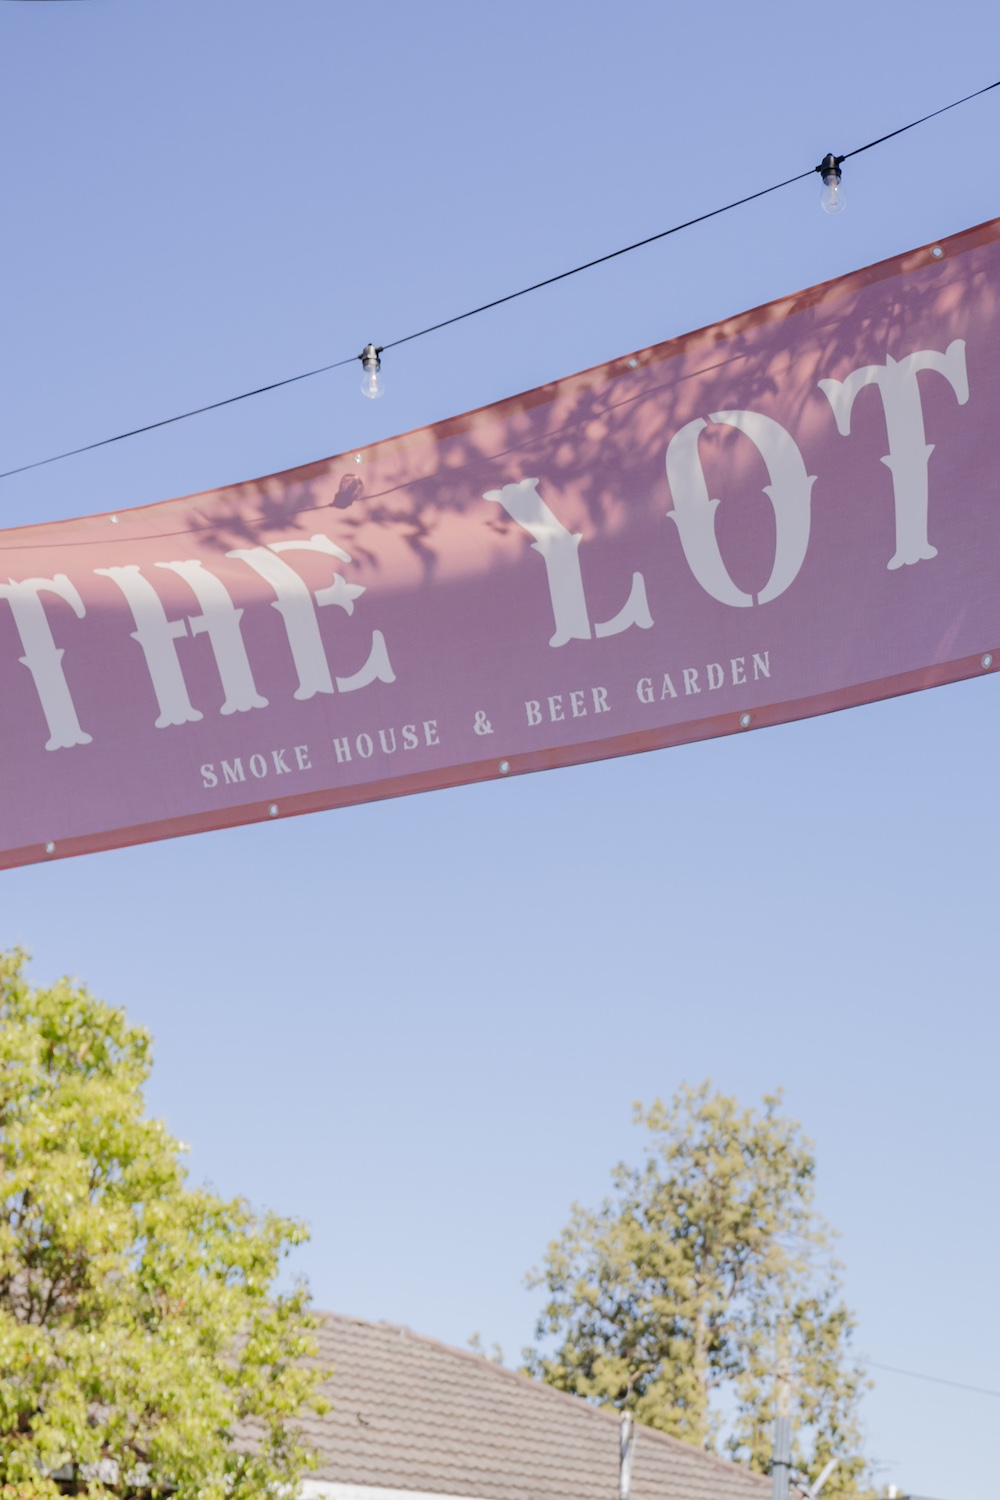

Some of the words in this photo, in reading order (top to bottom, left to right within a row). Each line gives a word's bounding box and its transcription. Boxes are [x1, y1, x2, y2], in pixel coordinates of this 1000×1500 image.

[0, 534, 396, 751] THE
[482, 338, 970, 648] LOT
[200, 745, 312, 788] SMOKE
[333, 719, 441, 763] HOUSE
[473, 710, 494, 737] &
[524, 686, 611, 726] BEER
[635, 651, 772, 704] GARDEN
